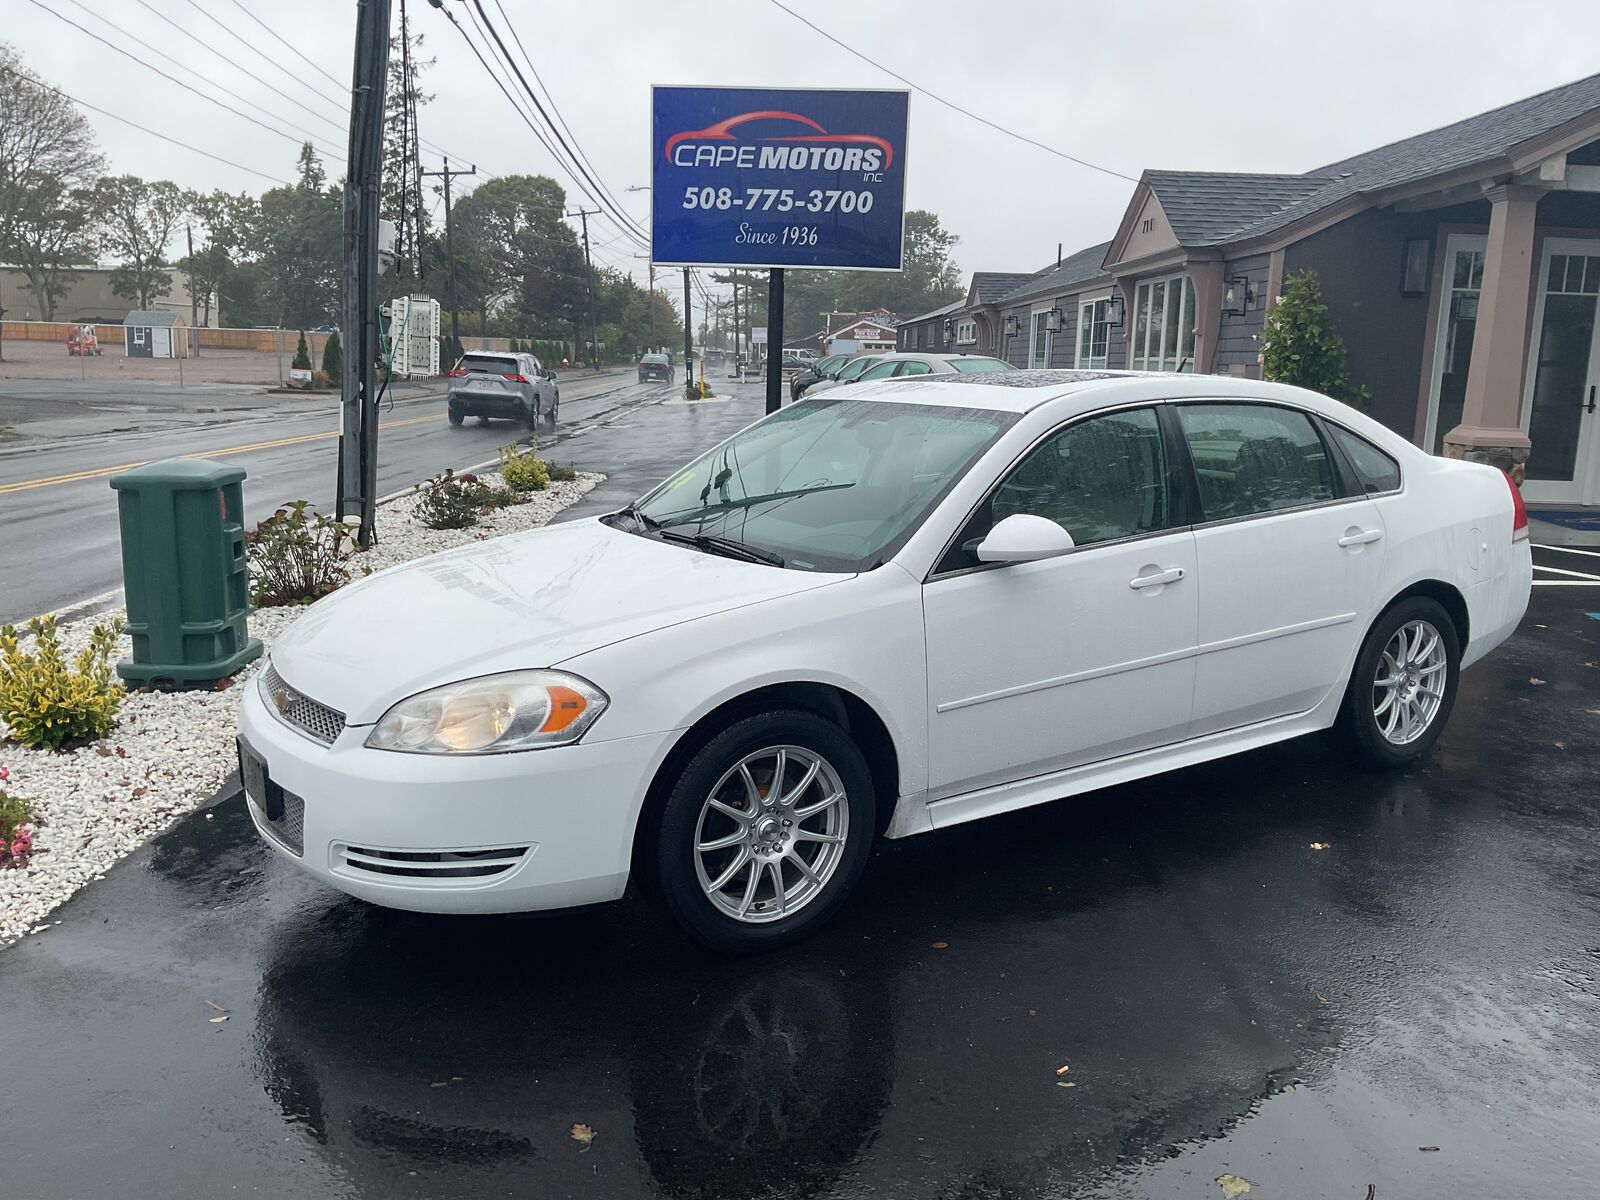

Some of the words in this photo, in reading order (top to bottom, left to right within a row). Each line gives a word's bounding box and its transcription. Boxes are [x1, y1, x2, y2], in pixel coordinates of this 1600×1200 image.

[674, 145, 756, 168] CAPE
[758, 146, 882, 171] MOTORS
[682, 187, 874, 213] 508-775-3700
[735, 222, 778, 244] Since
[782, 226, 818, 245] 1936
